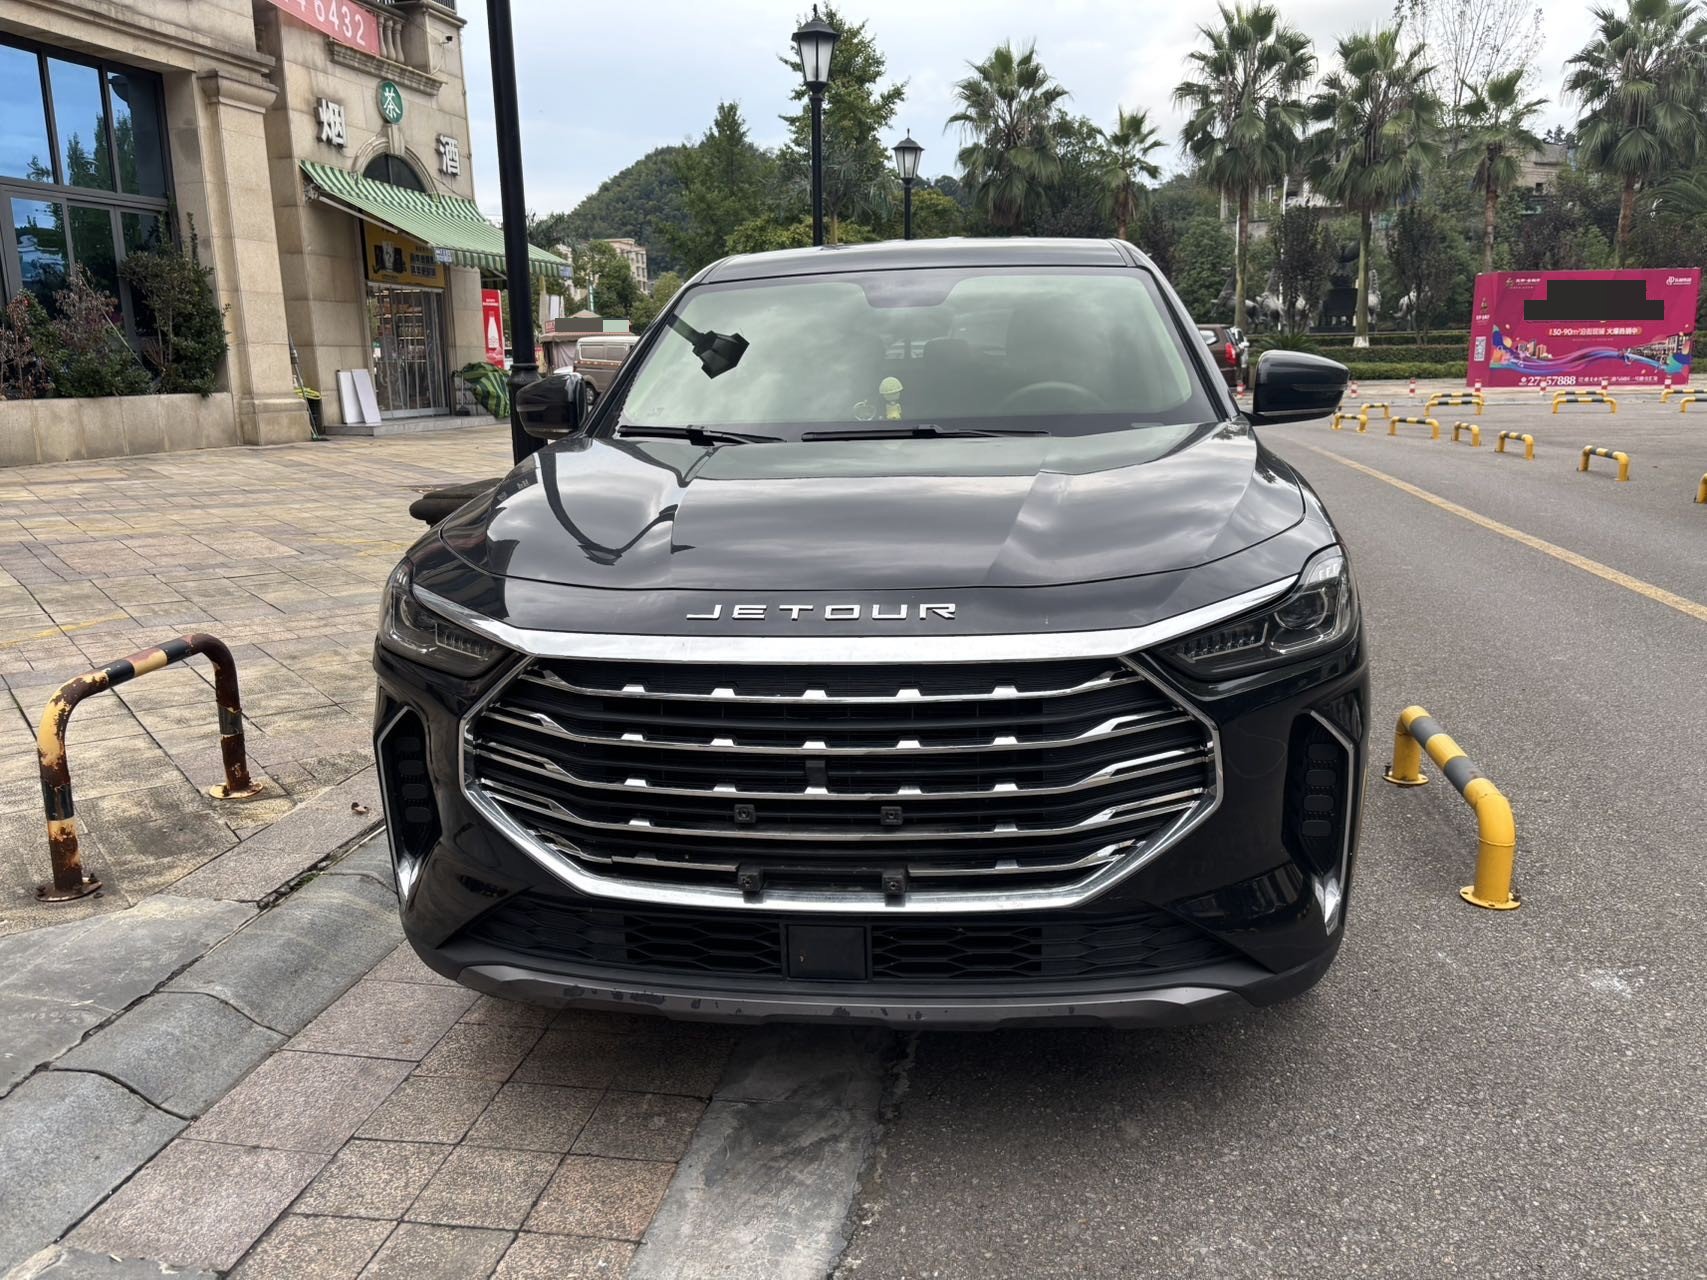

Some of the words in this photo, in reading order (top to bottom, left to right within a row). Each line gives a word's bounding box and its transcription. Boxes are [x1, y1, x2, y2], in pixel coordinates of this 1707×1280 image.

[285, 0, 366, 46] 6432
[384, 87, 401, 119] 茶
[318, 98, 347, 147] 烟
[438, 134, 461, 176] 酒
[1528, 376, 1576, 386] 2757888
[686, 603, 956, 620] JETOUR
